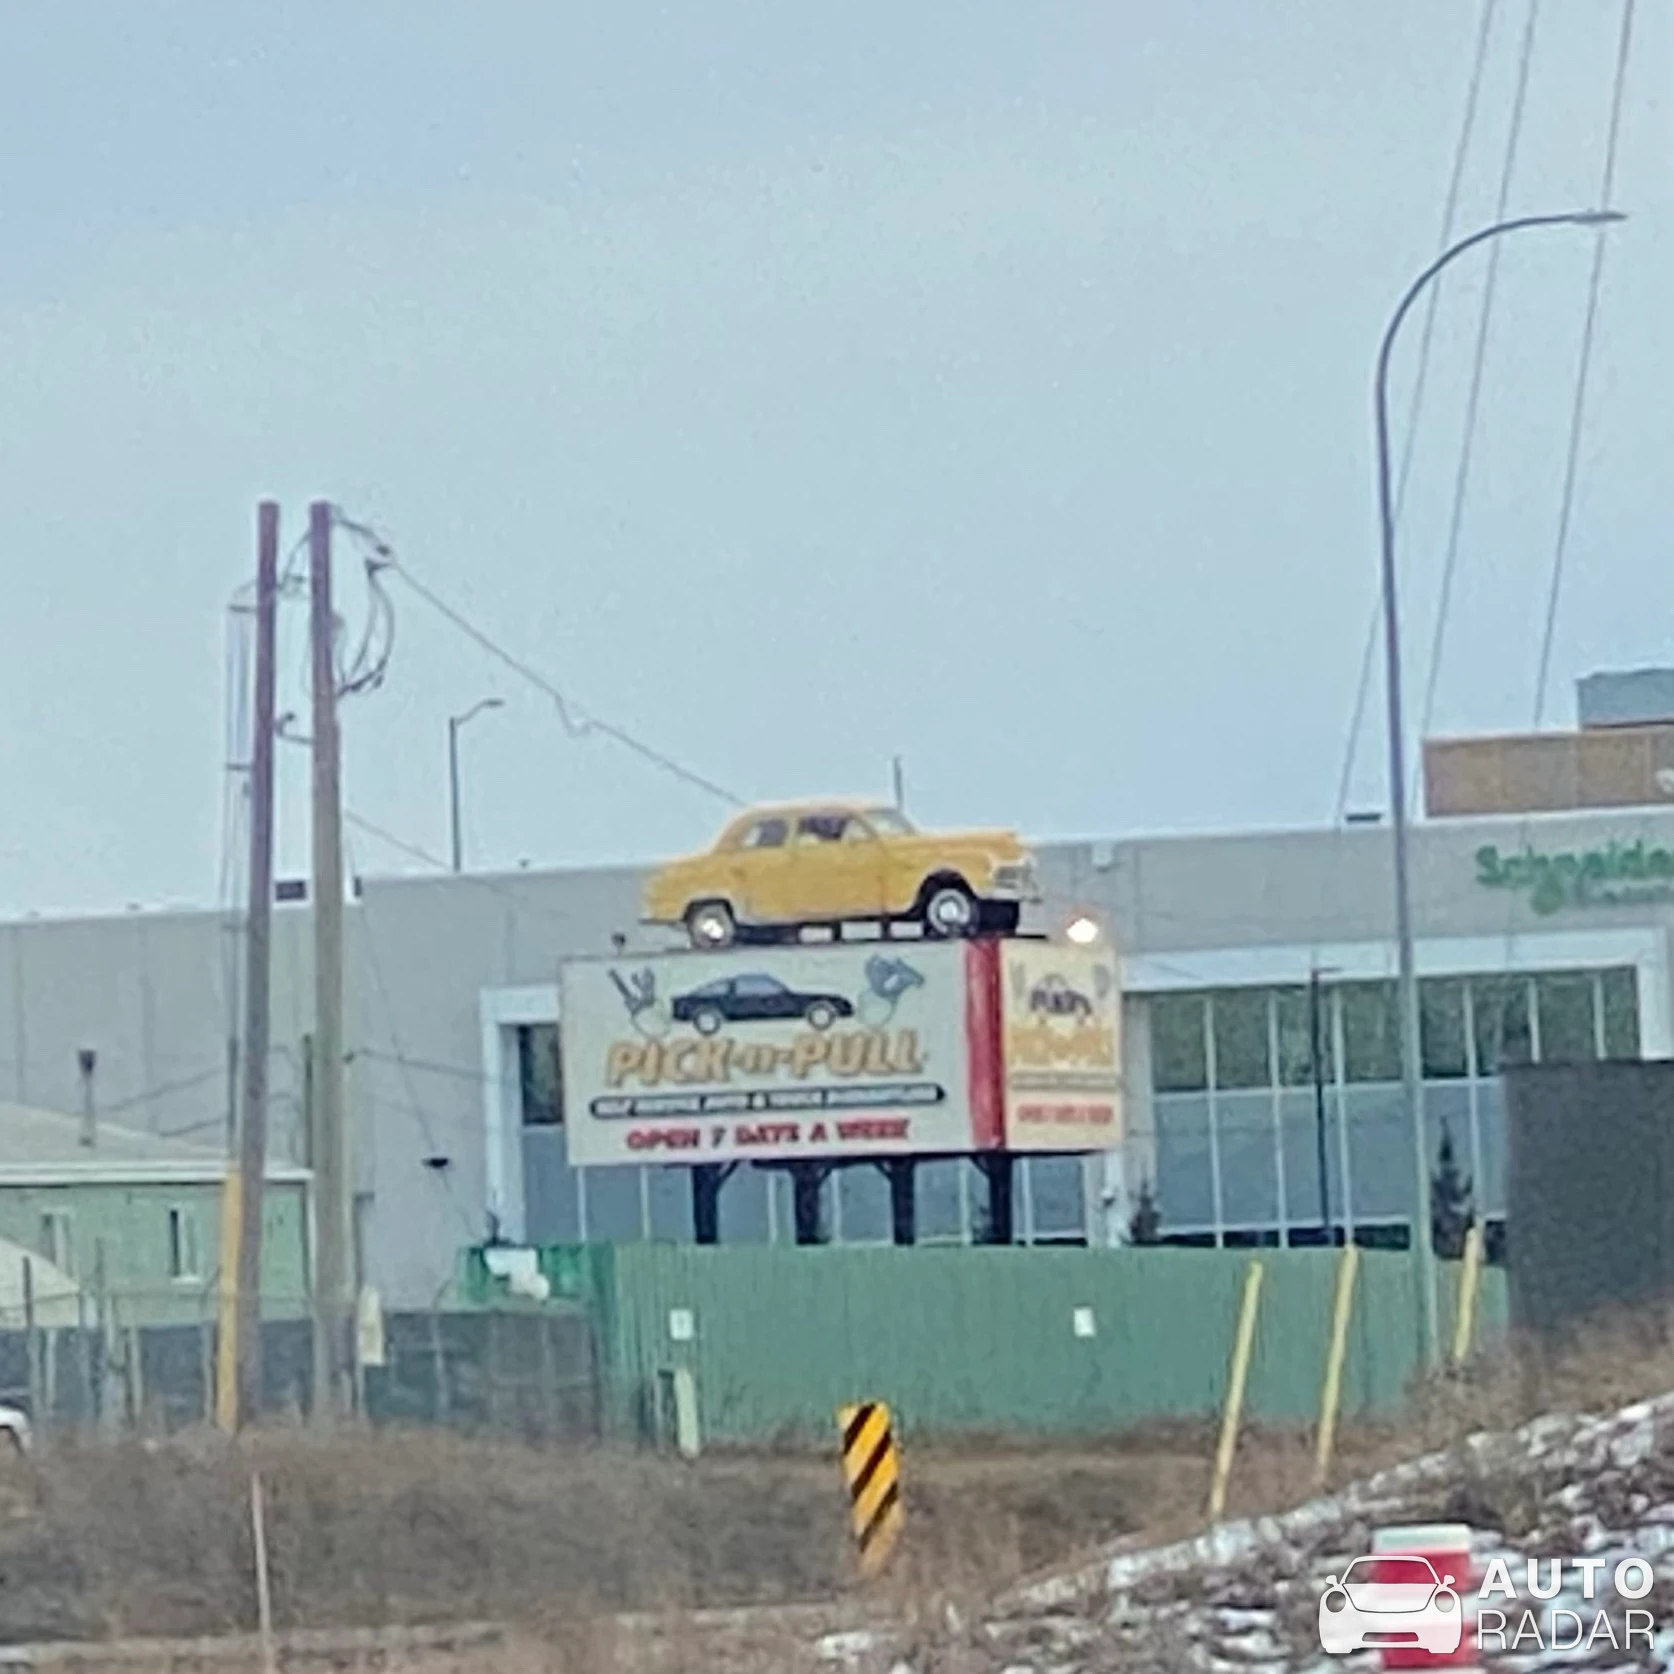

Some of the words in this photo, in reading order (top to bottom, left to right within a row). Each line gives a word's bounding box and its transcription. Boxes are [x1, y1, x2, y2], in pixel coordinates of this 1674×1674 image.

[626, 1128, 700, 1149] OPEN
[711, 1127, 726, 1148] 7
[735, 1121, 799, 1146] DAYS
[809, 1121, 828, 1143] A
[835, 1118, 911, 1141] WEEK
